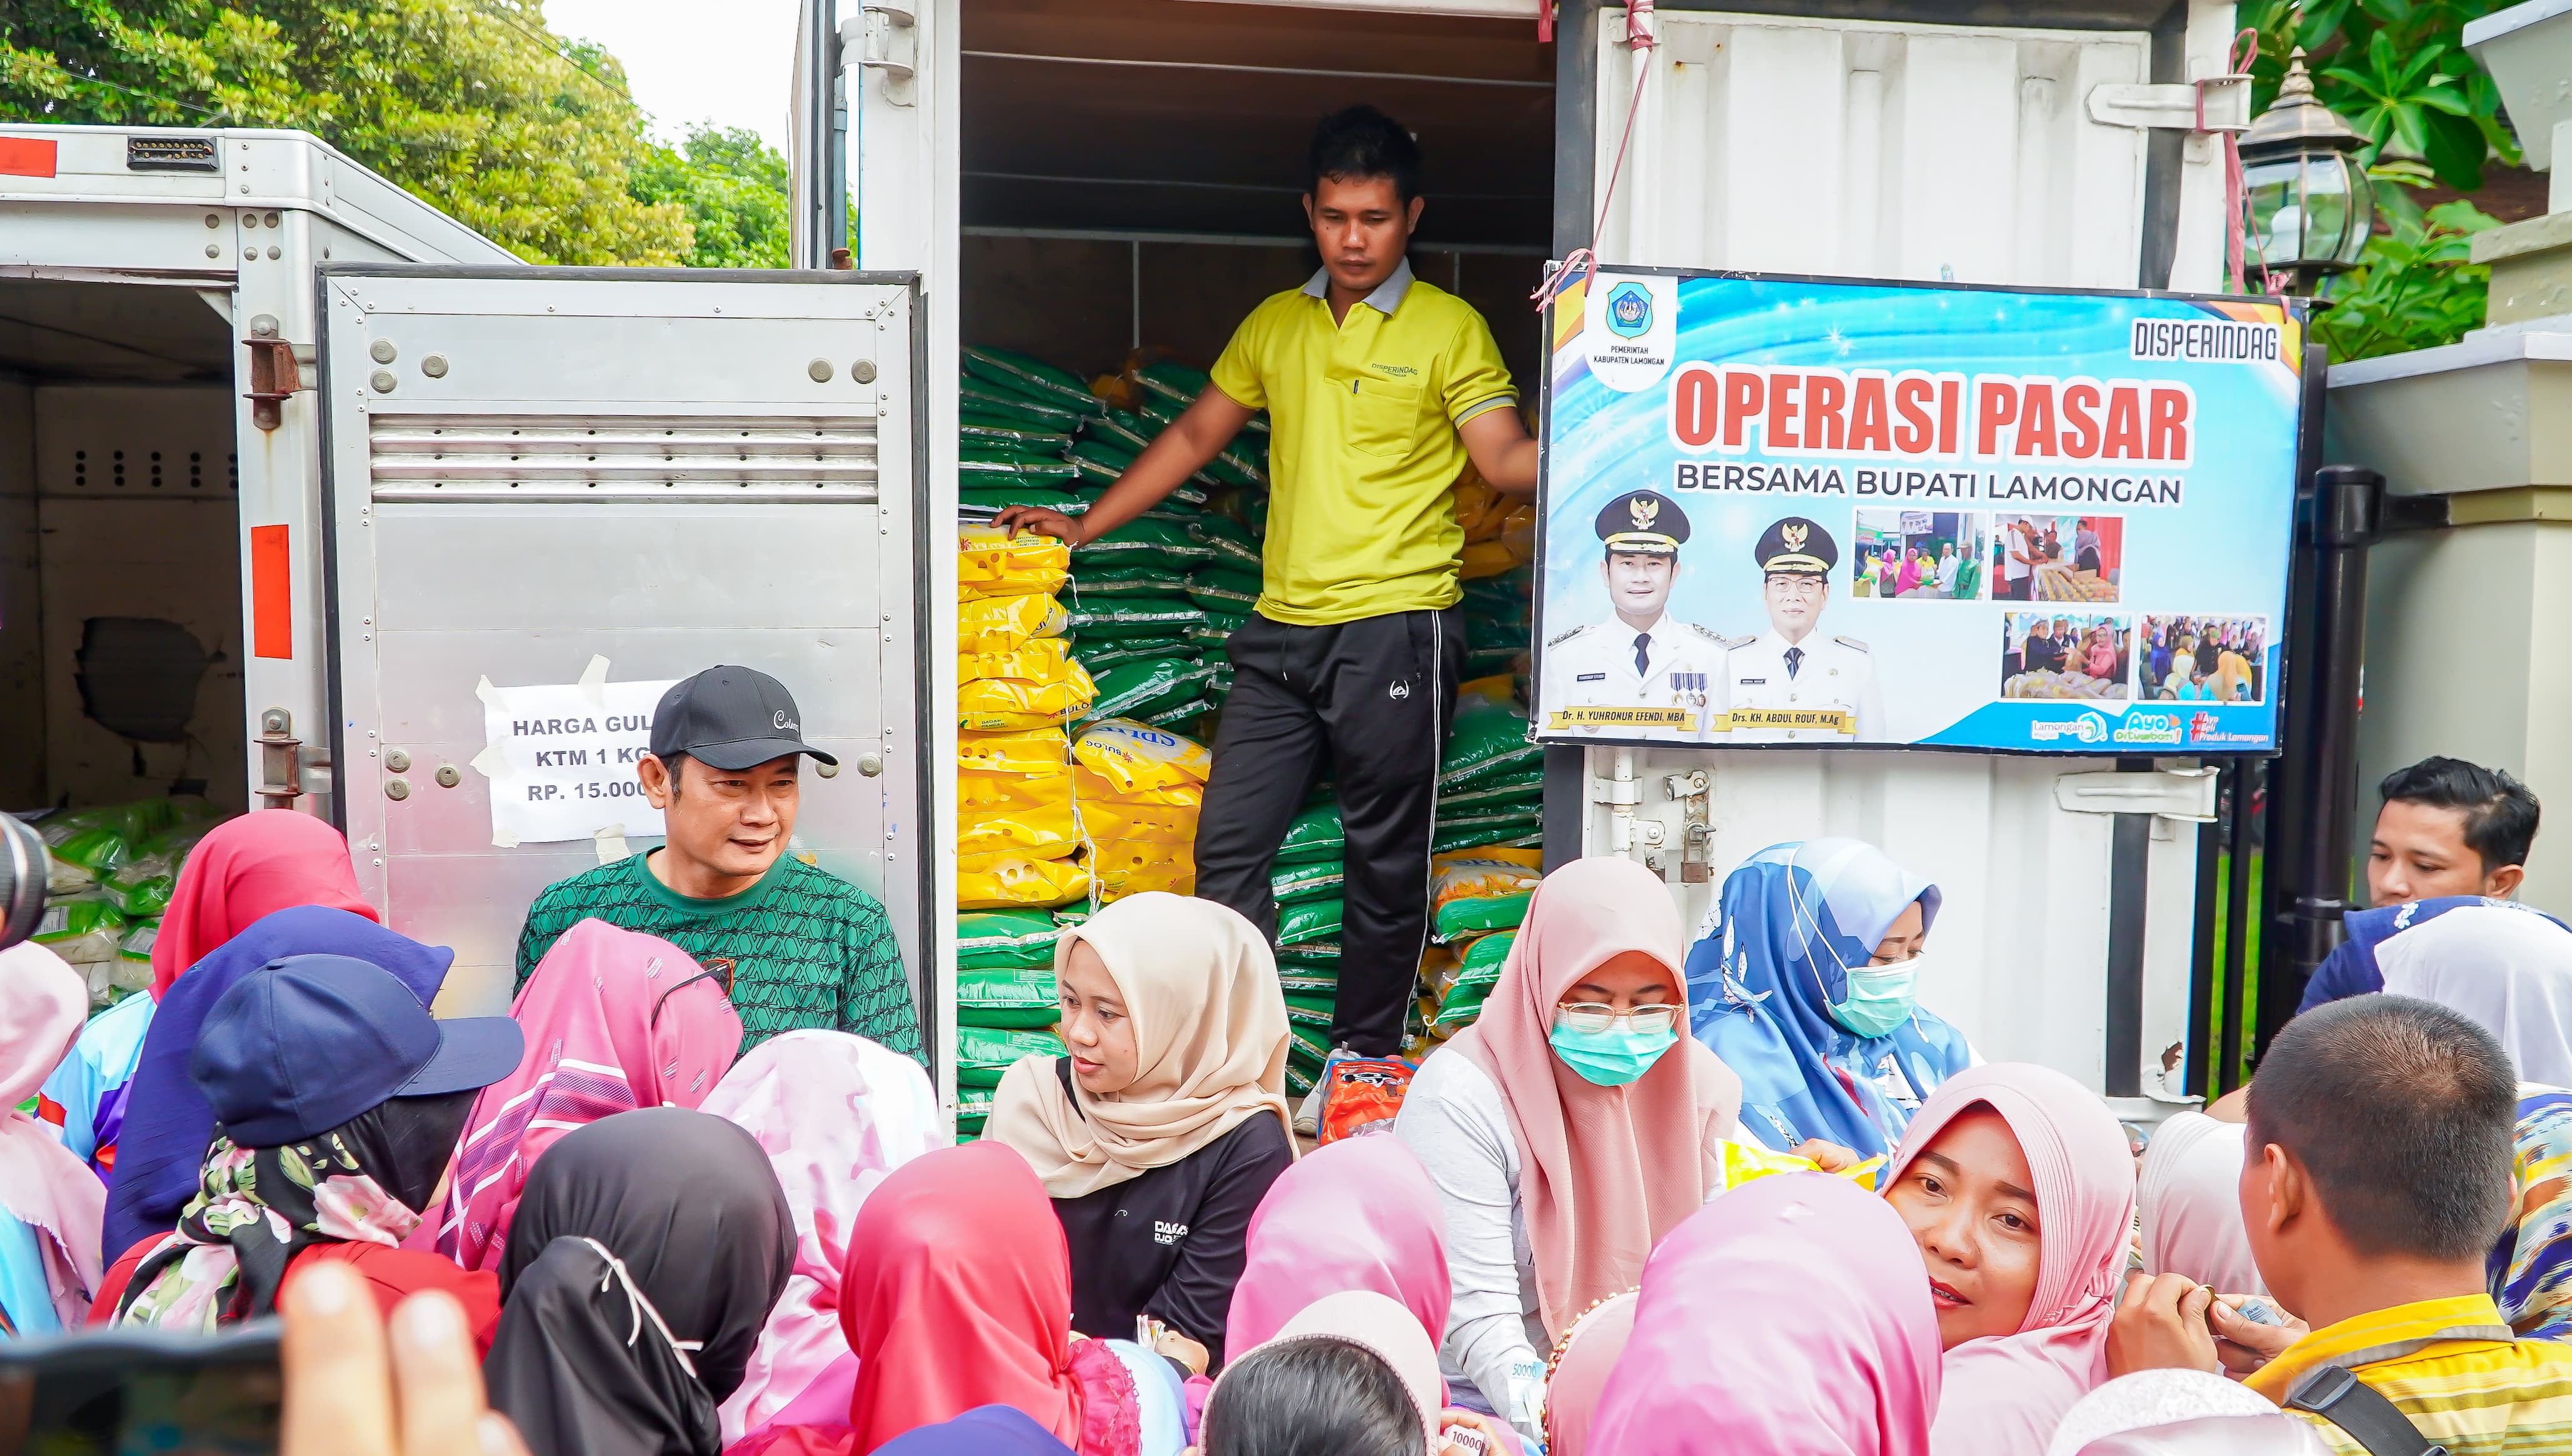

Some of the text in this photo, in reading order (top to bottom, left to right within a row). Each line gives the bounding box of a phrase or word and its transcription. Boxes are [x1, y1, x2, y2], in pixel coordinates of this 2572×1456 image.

[2135, 322, 2278, 361] DISPERINDAG
[1610, 345, 1649, 354] PEMERINTAH
[1593, 355, 1665, 366] KABUPATEN LAMONGAN
[1371, 363, 1419, 376] DISPERINDAG
[1675, 369, 2189, 461] OPERASI PASAR
[1677, 464, 2181, 504] BERSAMA BUPATI LAMONGAN
[1060, 702, 1092, 715] BULO
[1563, 711, 1685, 722] Dr. H. YUHRONUR EFENDI, MBA
[1732, 713, 1839, 725] Drs. KH. ABDUL ROUF, M.Ag
[2128, 714, 2167, 730] Ayo
[513, 715, 652, 736] HARGA GUL
[2034, 721, 2084, 733] Lamongan
[2200, 732, 2269, 744] Produk Lamongan
[1085, 740, 1122, 756] BULOG
[536, 750, 587, 767] KTM
[597, 749, 607, 765] 1
[528, 785, 565, 801] RP.
[1512, 1363, 1537, 1378] 50000
